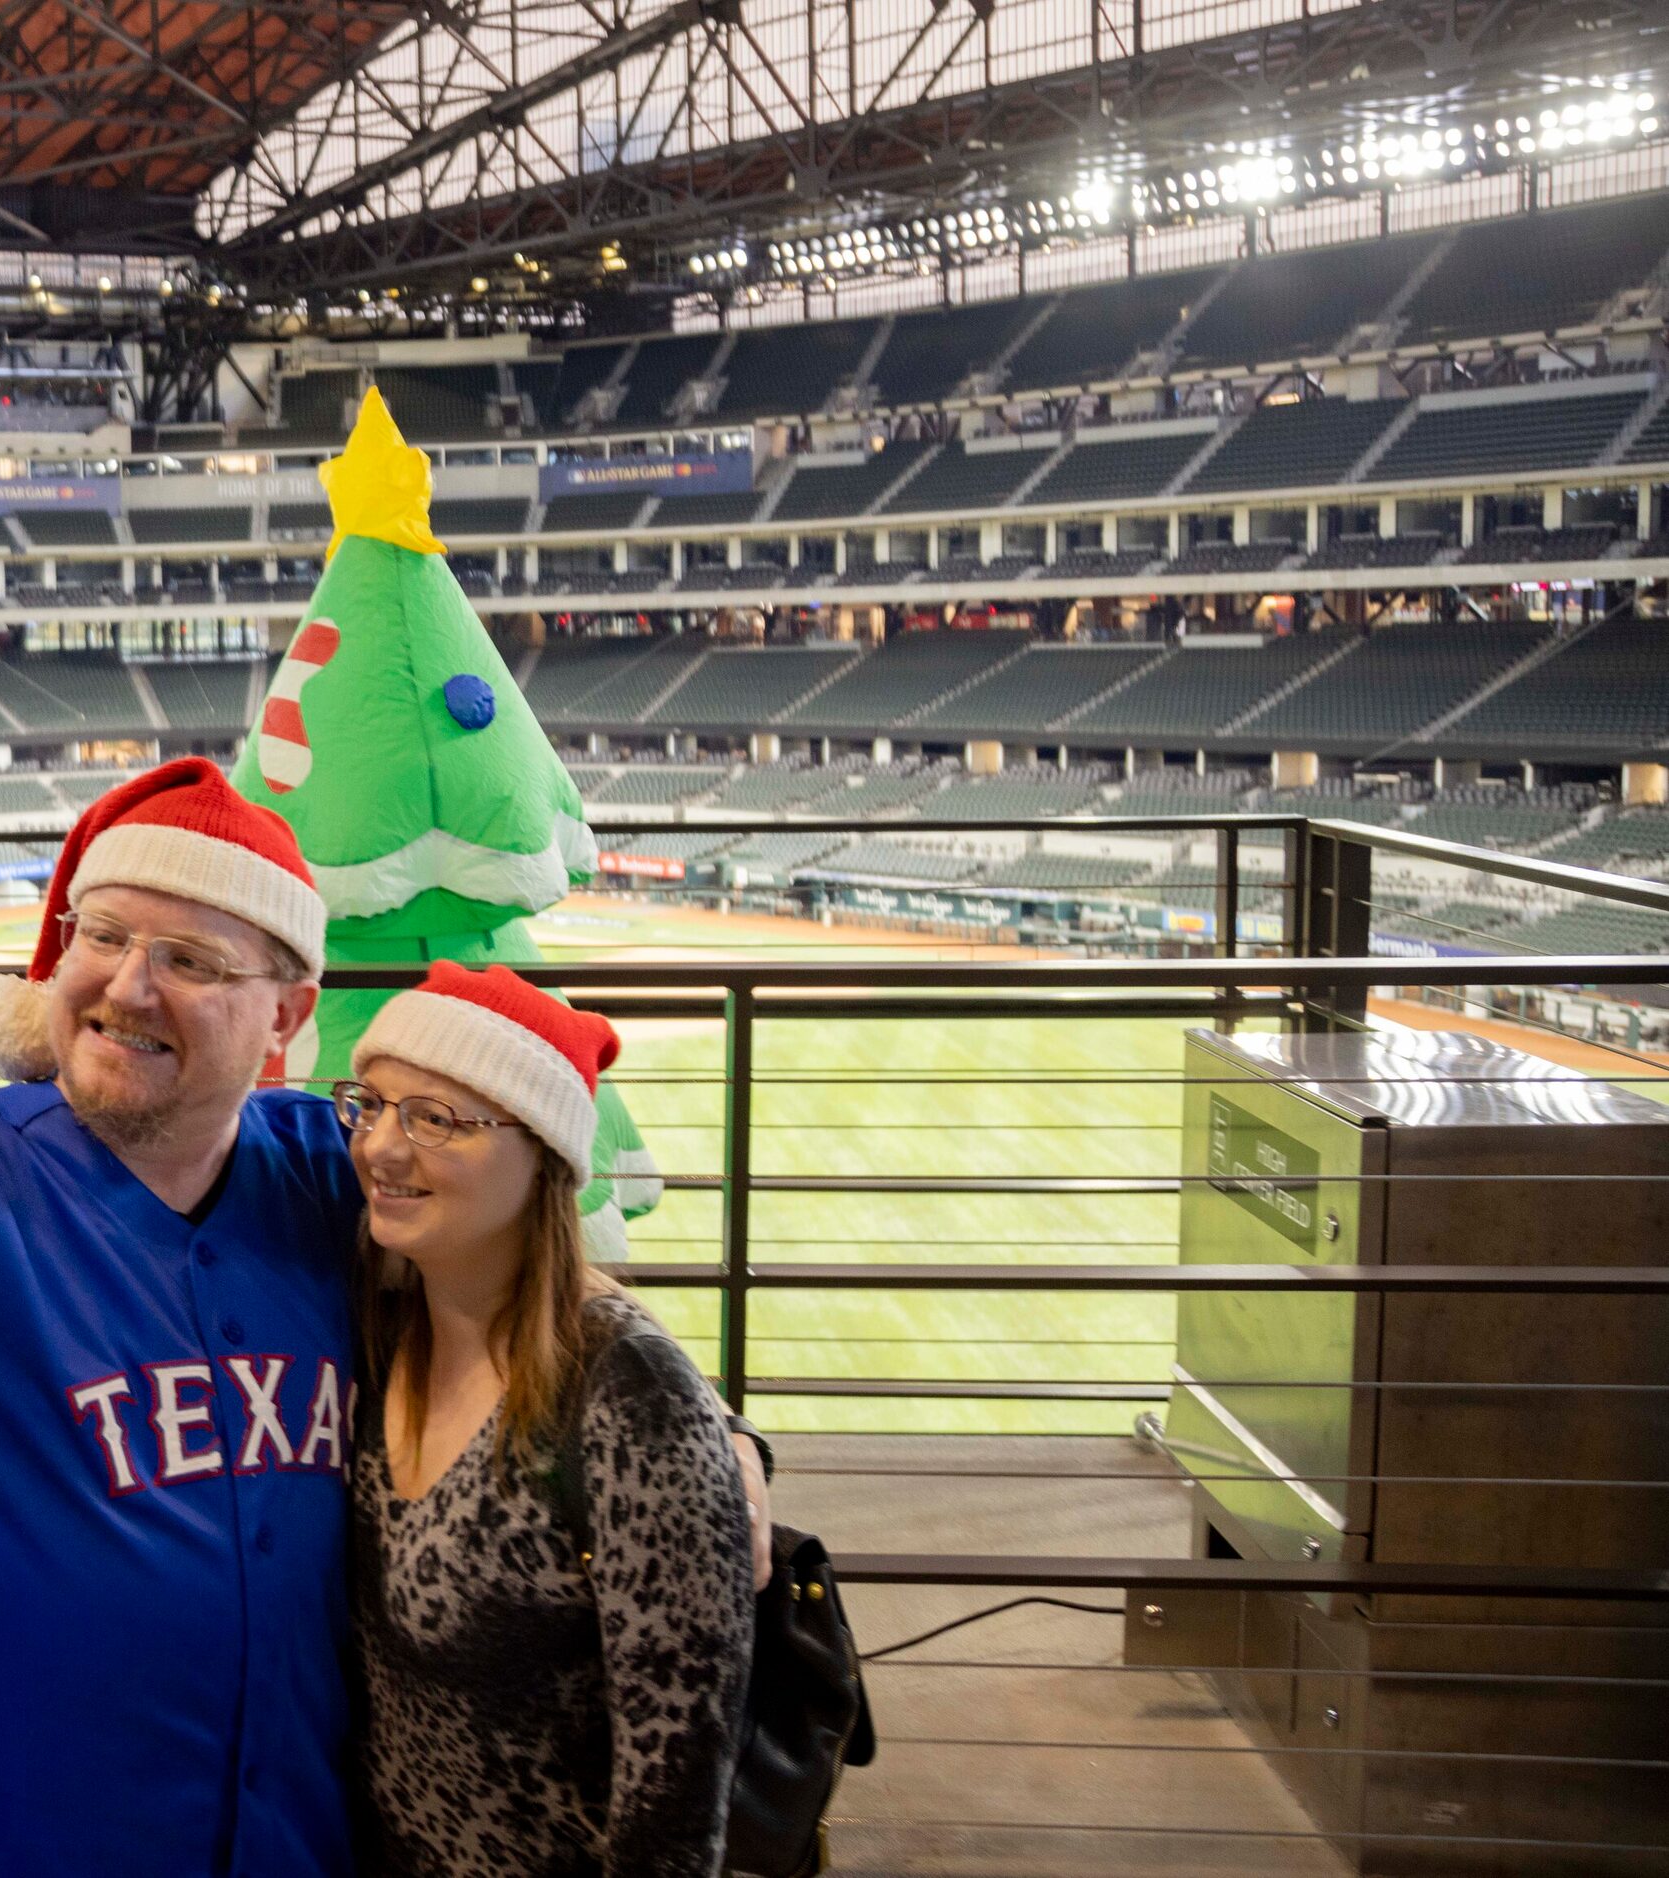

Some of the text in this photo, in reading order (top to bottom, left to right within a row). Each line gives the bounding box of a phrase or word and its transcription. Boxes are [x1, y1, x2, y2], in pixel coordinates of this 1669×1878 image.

[640, 464, 674, 479] GAME
[25, 486, 57, 499] GAME
[218, 477, 314, 497] HOME OF THE
[1256, 1139, 1287, 1176] HIGH
[1275, 1188, 1312, 1229] FIELD
[65, 1354, 359, 1498] TEXA
